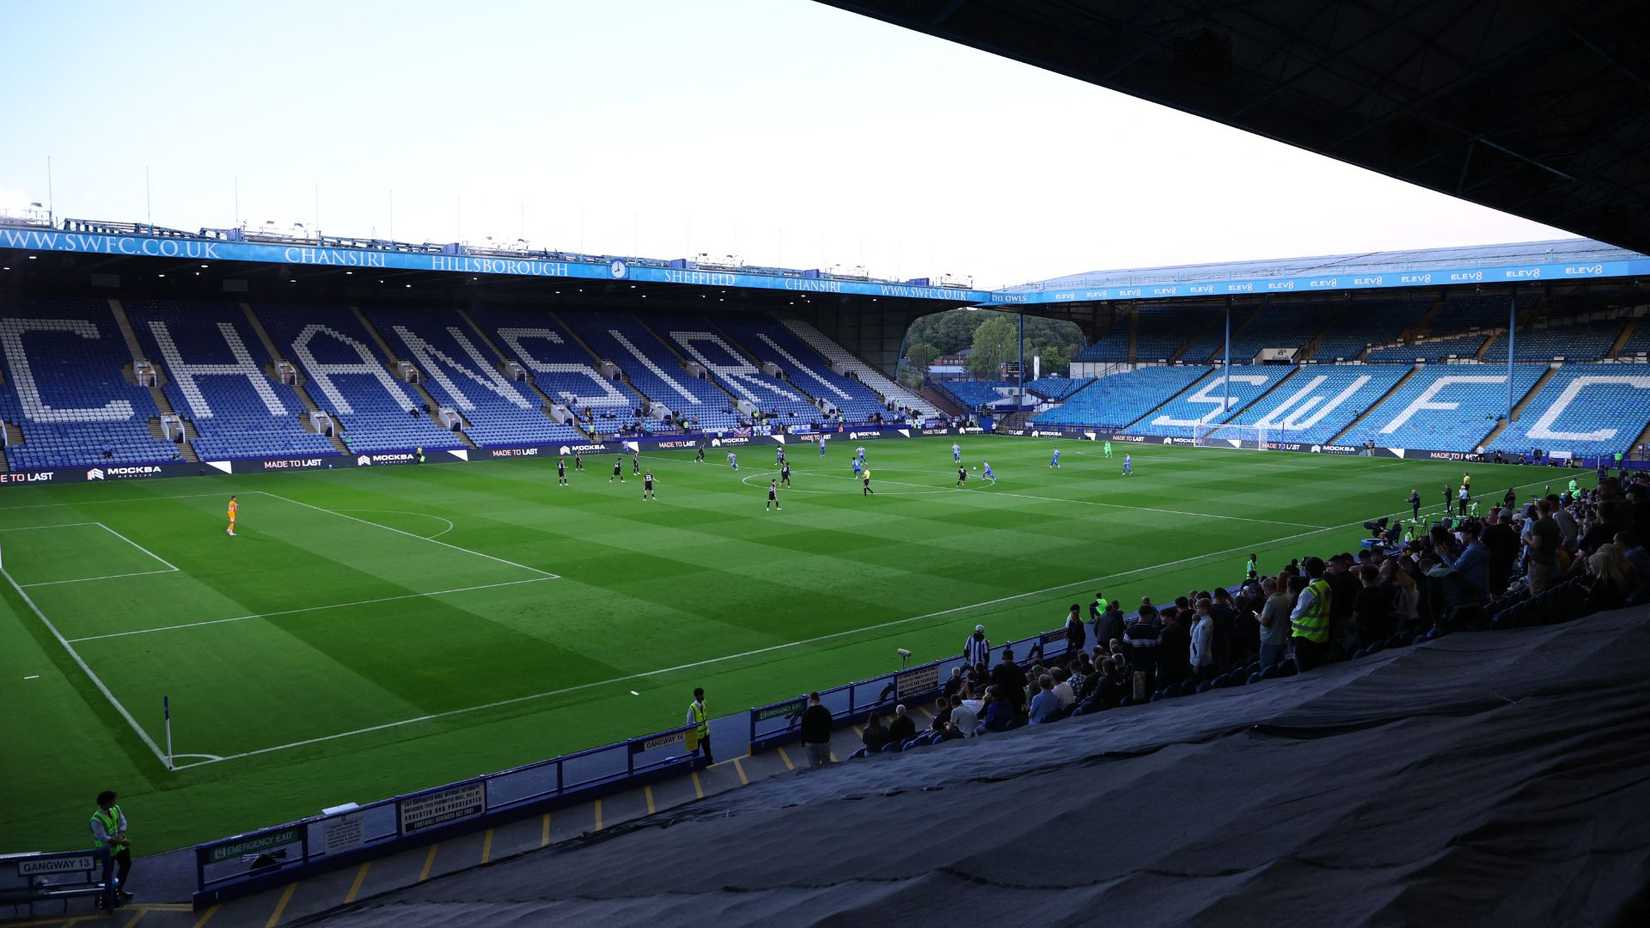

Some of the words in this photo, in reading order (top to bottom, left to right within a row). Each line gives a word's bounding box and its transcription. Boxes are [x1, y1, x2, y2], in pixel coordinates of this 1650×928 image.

[284, 247, 385, 268] CHANSIRI
[432, 255, 569, 277] HILLSBOROUGH
[1565, 265, 1603, 275] ELEV8
[1401, 273, 1432, 283] ELEV8
[1451, 271, 1483, 281] ELEV8
[1506, 268, 1540, 279] ELEV8
[664, 271, 736, 287] SHEFFIELD
[1310, 278, 1337, 287] ELEV8
[1354, 275, 1383, 285] ELEV8
[784, 278, 841, 292] CHANSIRI
[522, 448, 538, 456] LAST
[373, 453, 414, 462] MOCKBA
[264, 460, 288, 469] MADE
[288, 460, 300, 468] TO
[302, 458, 322, 467] LAST
[107, 465, 162, 475] MOCKBA
[11, 473, 25, 482] TO
[27, 472, 54, 482] LAST
[23, 859, 75, 873] GANGWAY
